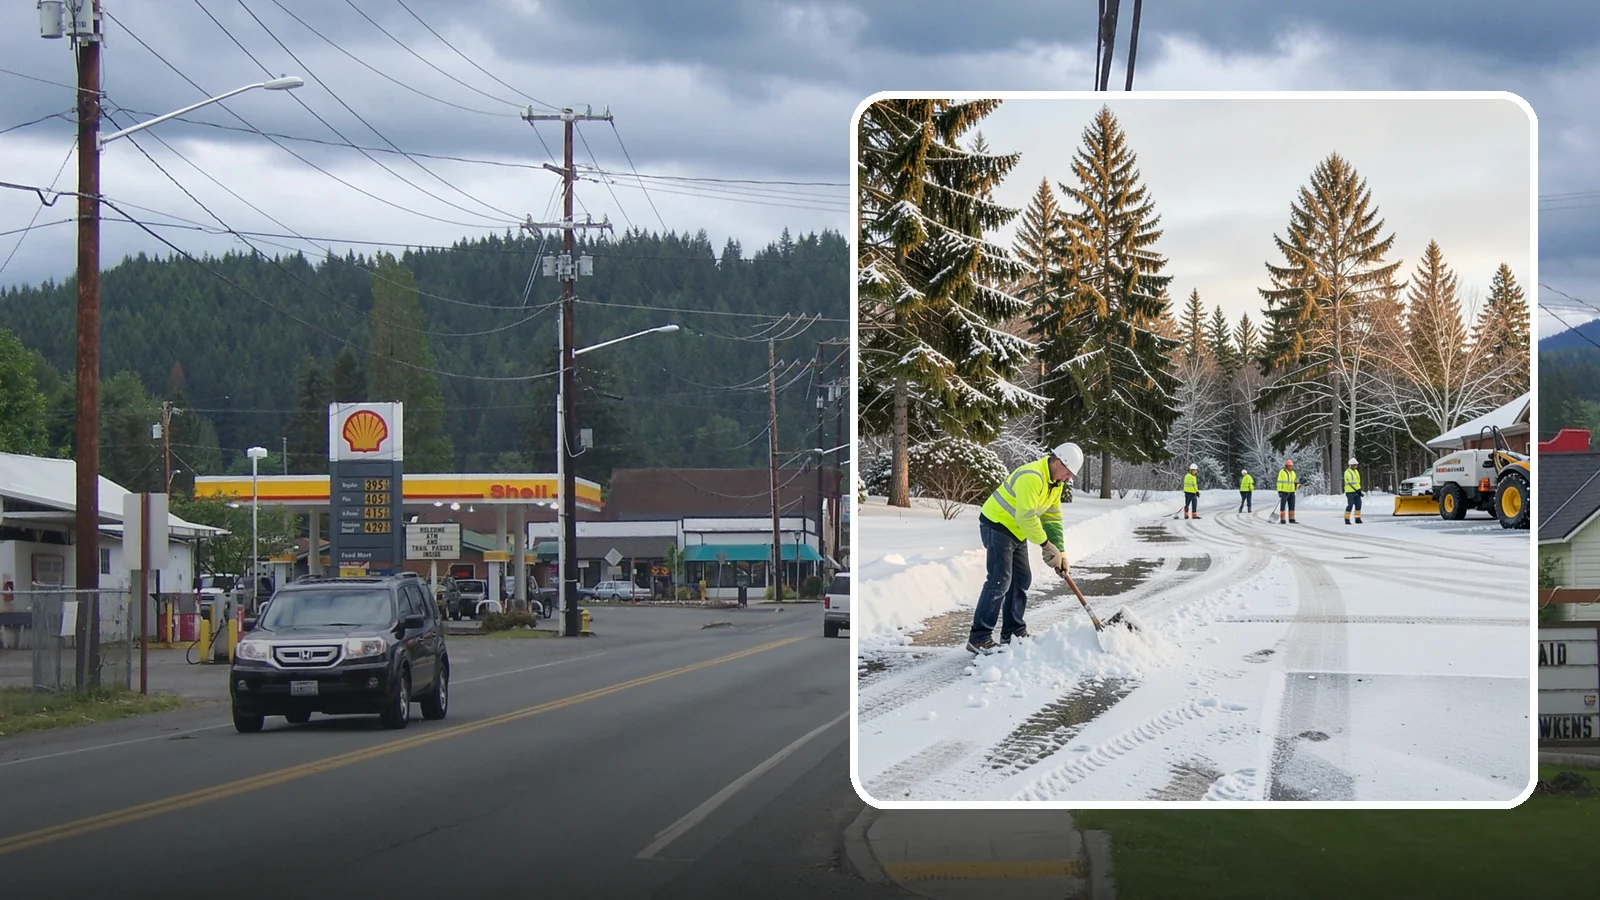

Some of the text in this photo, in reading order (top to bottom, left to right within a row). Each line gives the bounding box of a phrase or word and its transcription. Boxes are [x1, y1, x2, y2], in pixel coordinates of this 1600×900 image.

[365, 480, 384, 490] 395
[490, 484, 547, 499] Shell
[365, 494, 384, 504] 405
[365, 508, 384, 518] 415
[365, 522, 384, 532] 429
